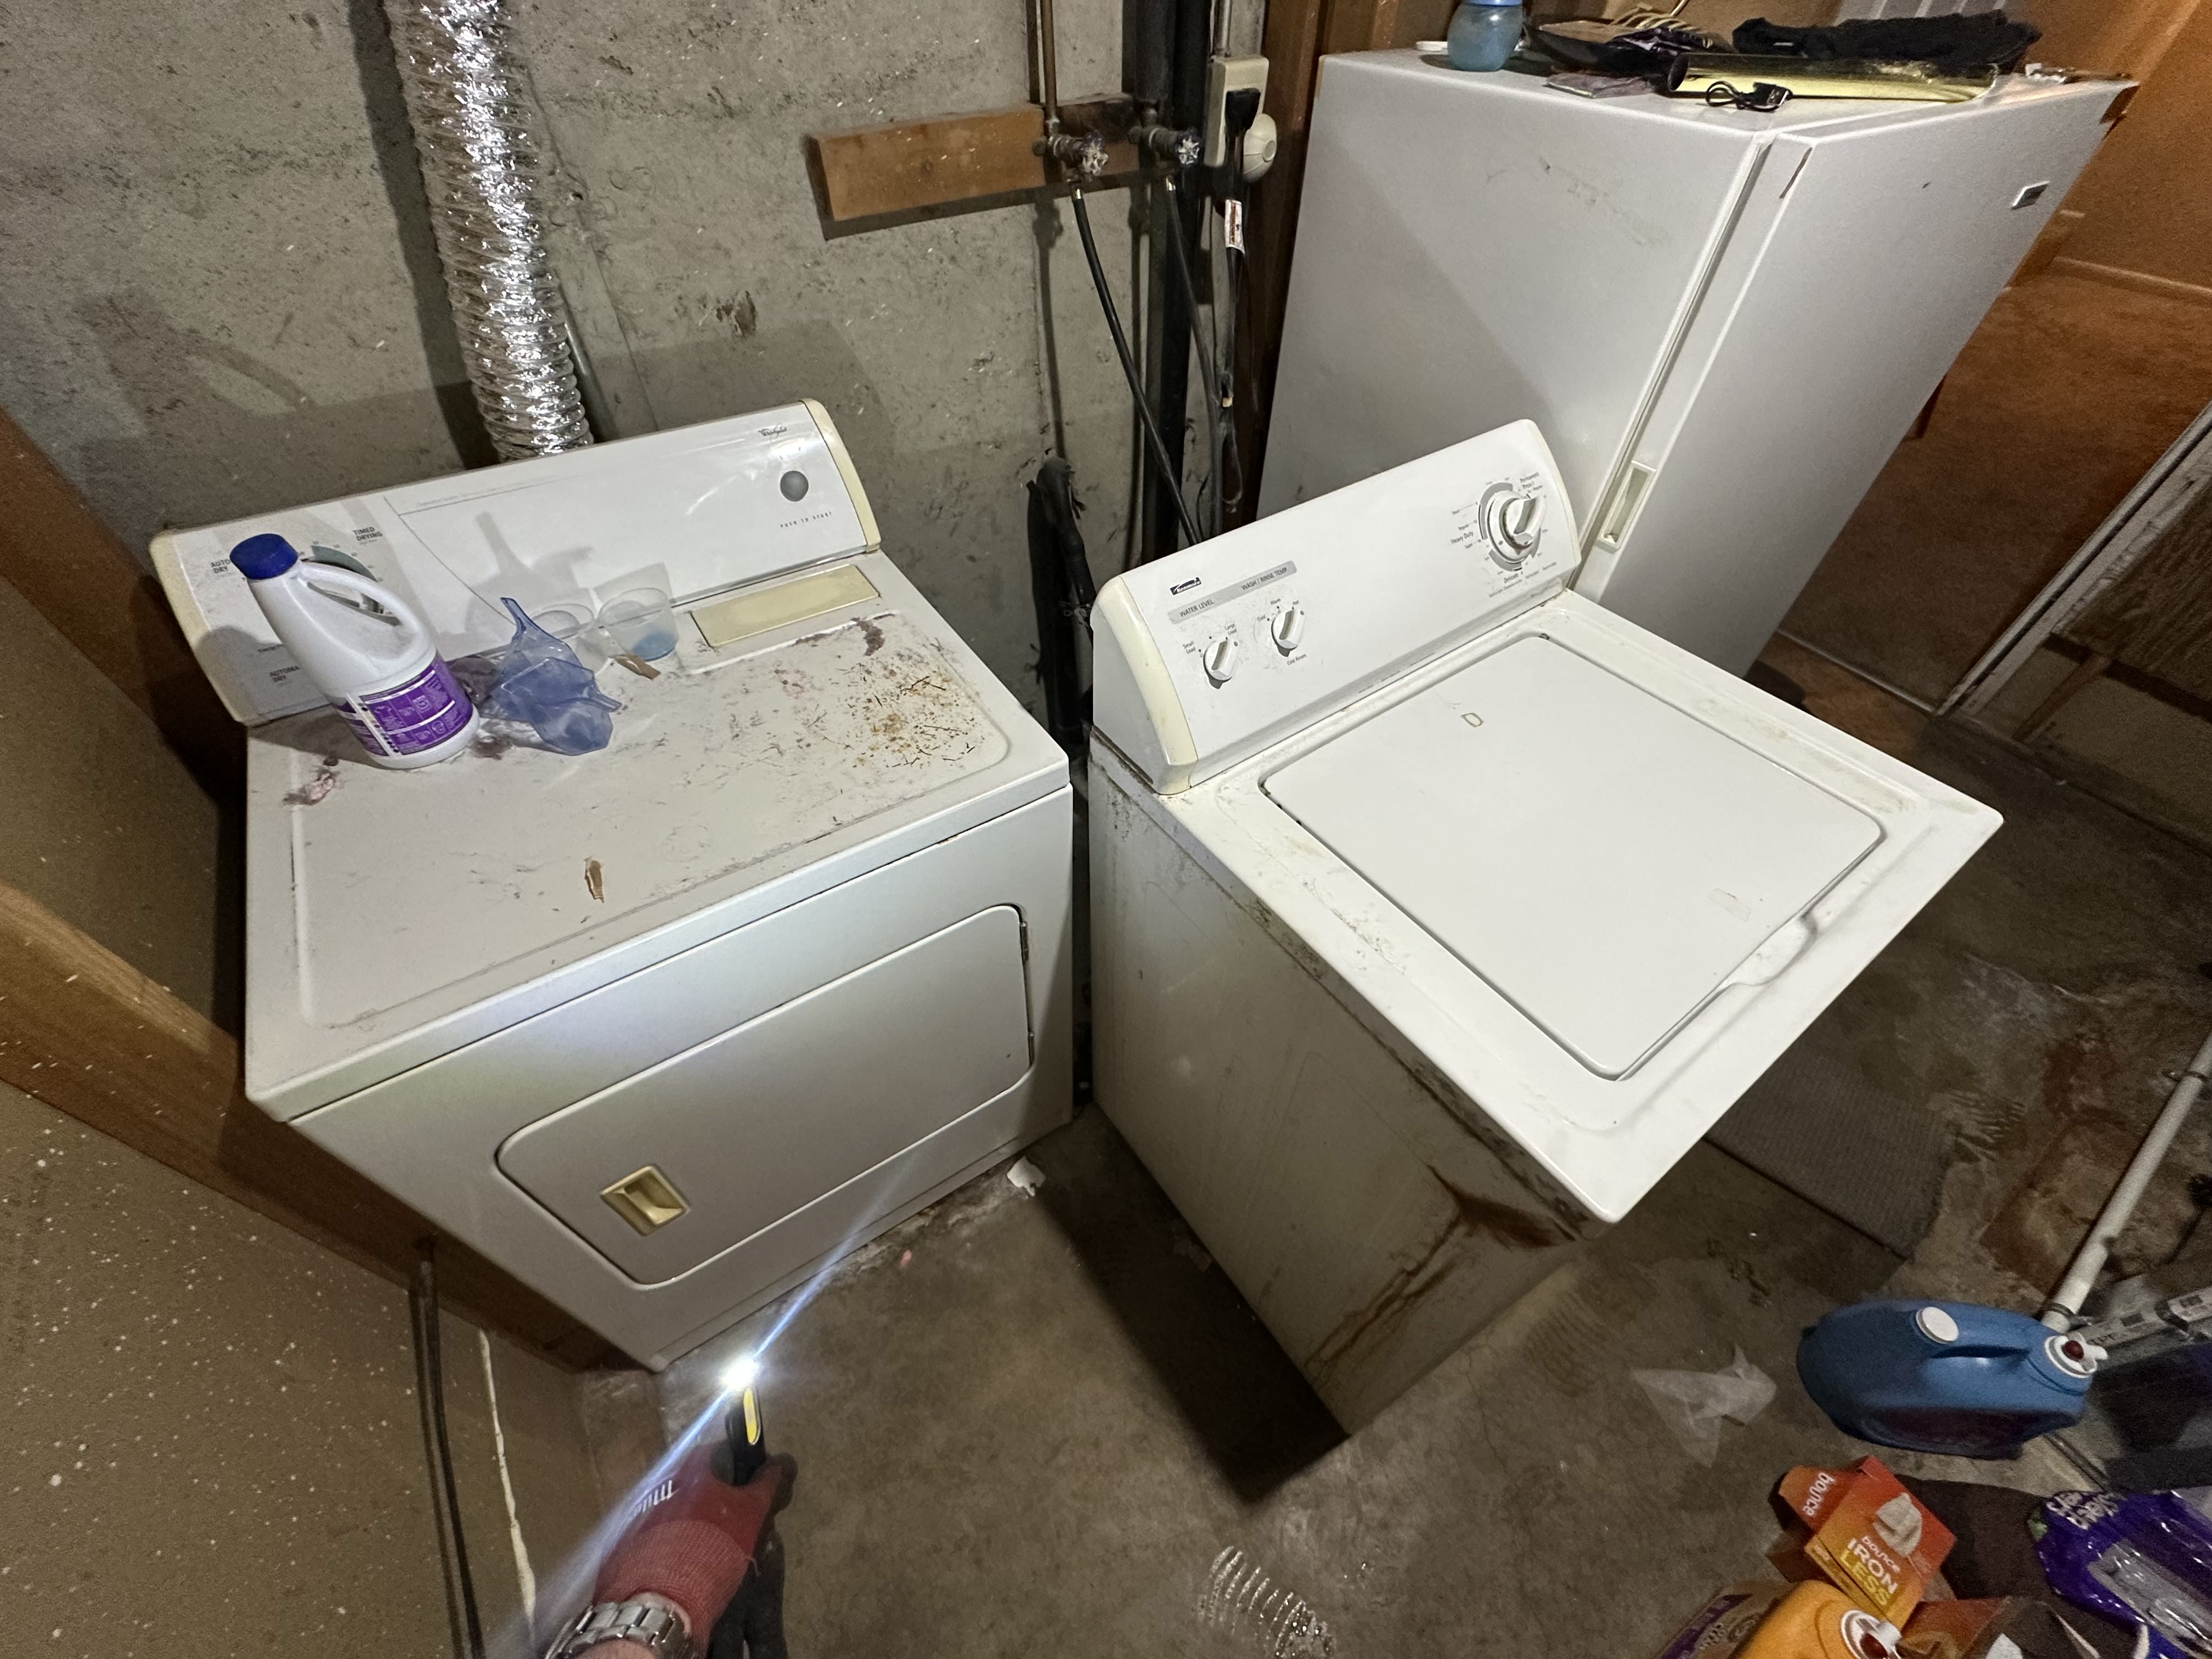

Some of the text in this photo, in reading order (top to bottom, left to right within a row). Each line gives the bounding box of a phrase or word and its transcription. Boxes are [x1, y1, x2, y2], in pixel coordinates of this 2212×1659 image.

[812, 511, 832, 520] START
[353, 526, 375, 535] TIMED
[357, 531, 383, 541] DRYING
[1451, 535, 1464, 544] Heavy
[211, 559, 230, 567] AUTO
[1177, 580, 1201, 593] Kenmore
[1242, 582, 1257, 590] WASH
[1260, 572, 1275, 583] RINSE
[1274, 567, 1288, 577] TEMP
[1180, 599, 1215, 618] WATER LEVEL
[1803, 1472, 1835, 1516] bounce
[1861, 1536, 1900, 1573] bounce
[1847, 1538, 1898, 1594] IRON
[1840, 1550, 1891, 1605] LESS
